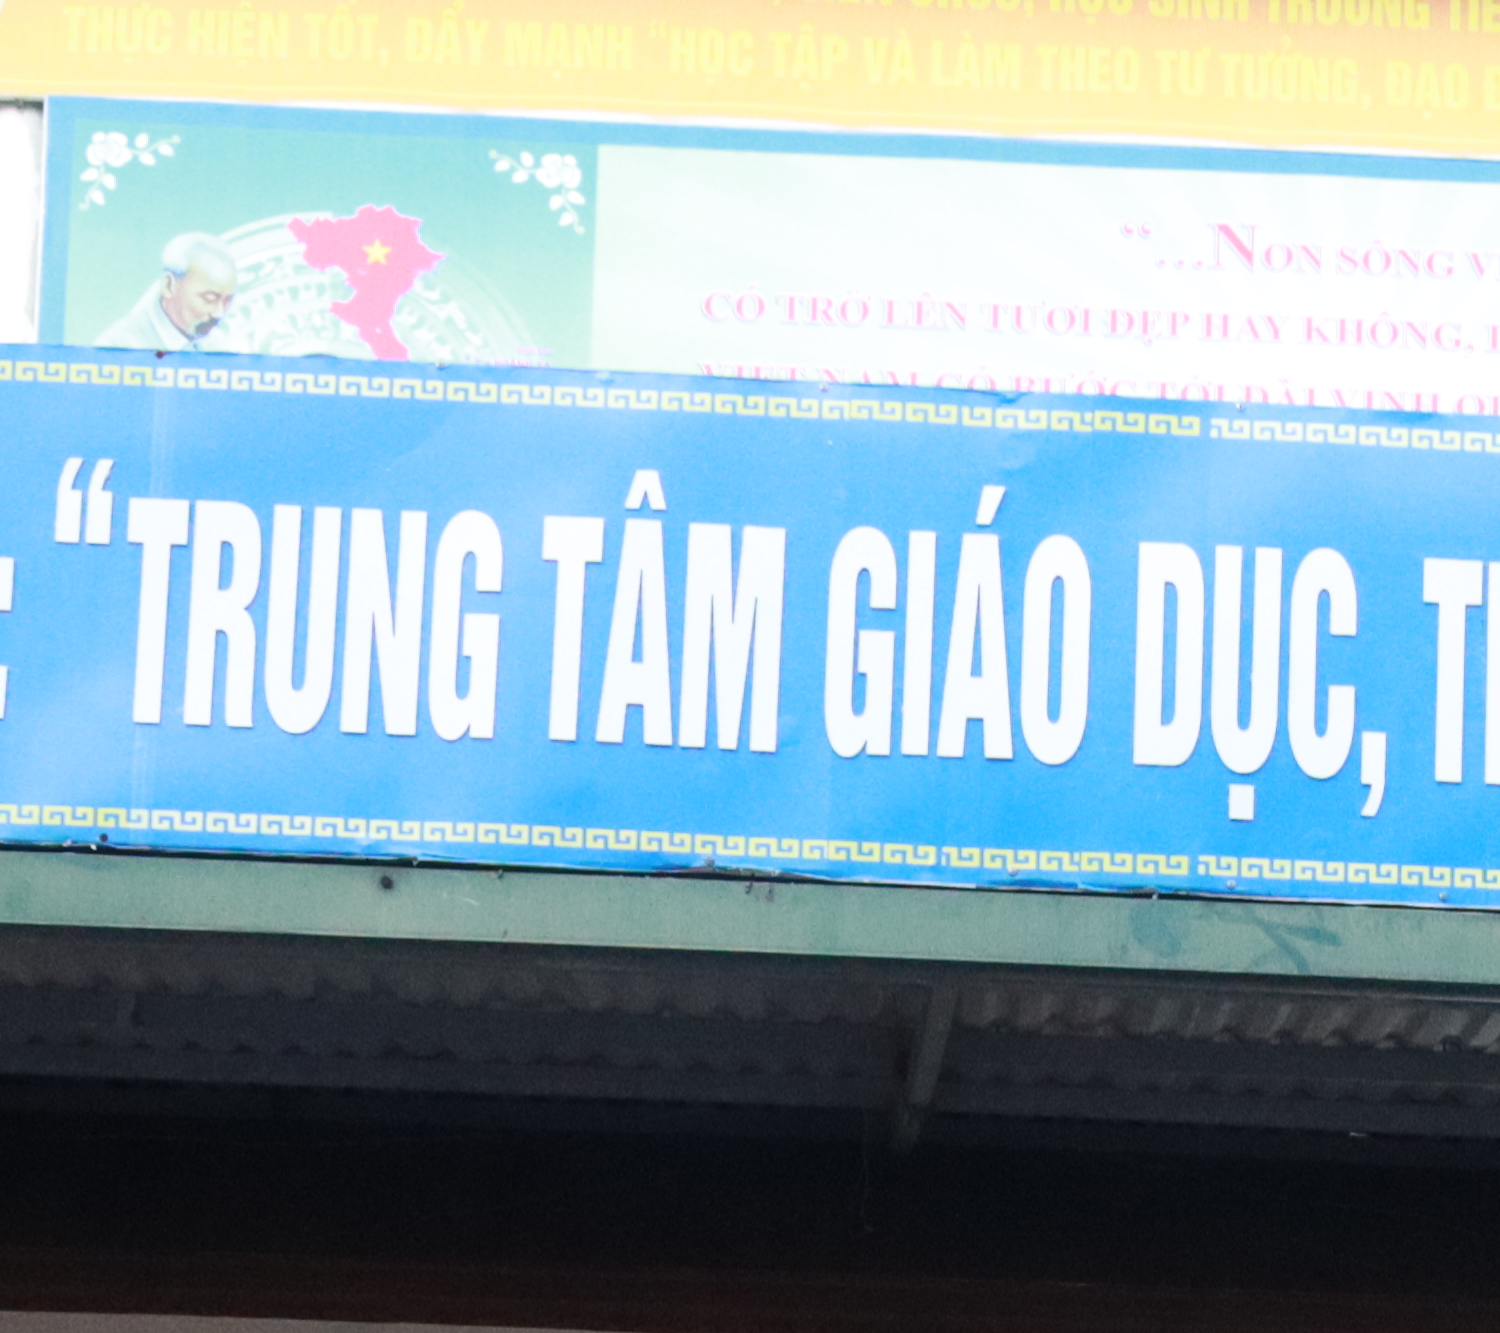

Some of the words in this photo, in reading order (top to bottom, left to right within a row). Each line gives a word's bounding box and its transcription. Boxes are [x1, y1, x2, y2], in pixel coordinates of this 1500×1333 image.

[61, 7, 173, 63] THỰC
[187, 8, 291, 67] HIỆN
[303, 3, 390, 67] TỐT,
[402, 3, 490, 68] ĐẨY
[503, 22, 634, 79] MẠNH
[766, 22, 851, 91] TẬP
[861, 29, 917, 84] VÀ
[930, 31, 1022, 92] LÀM
[1035, 45, 1141, 95] THEO
[1155, 45, 1211, 97] TƯ
[1218, 35, 1372, 111] TƯỞNG,
[1385, 59, 1470, 119] ĐẠO
[1335, 240, 1455, 279] SÔNG
[700, 285, 768, 325] CÓ
[879, 291, 970, 330] LÊN
[979, 299, 1093, 337] TƯƠI
[1102, 308, 1191, 347] ĐẸP
[1199, 313, 1283, 346] HAY
[1299, 311, 1477, 359] KHÔNG,
[52, 457, 505, 741] “TRUNG
[542, 469, 790, 755] TÂM
[823, 484, 1094, 767] GIÁO
[1132, 540, 1392, 822] DỤC,
